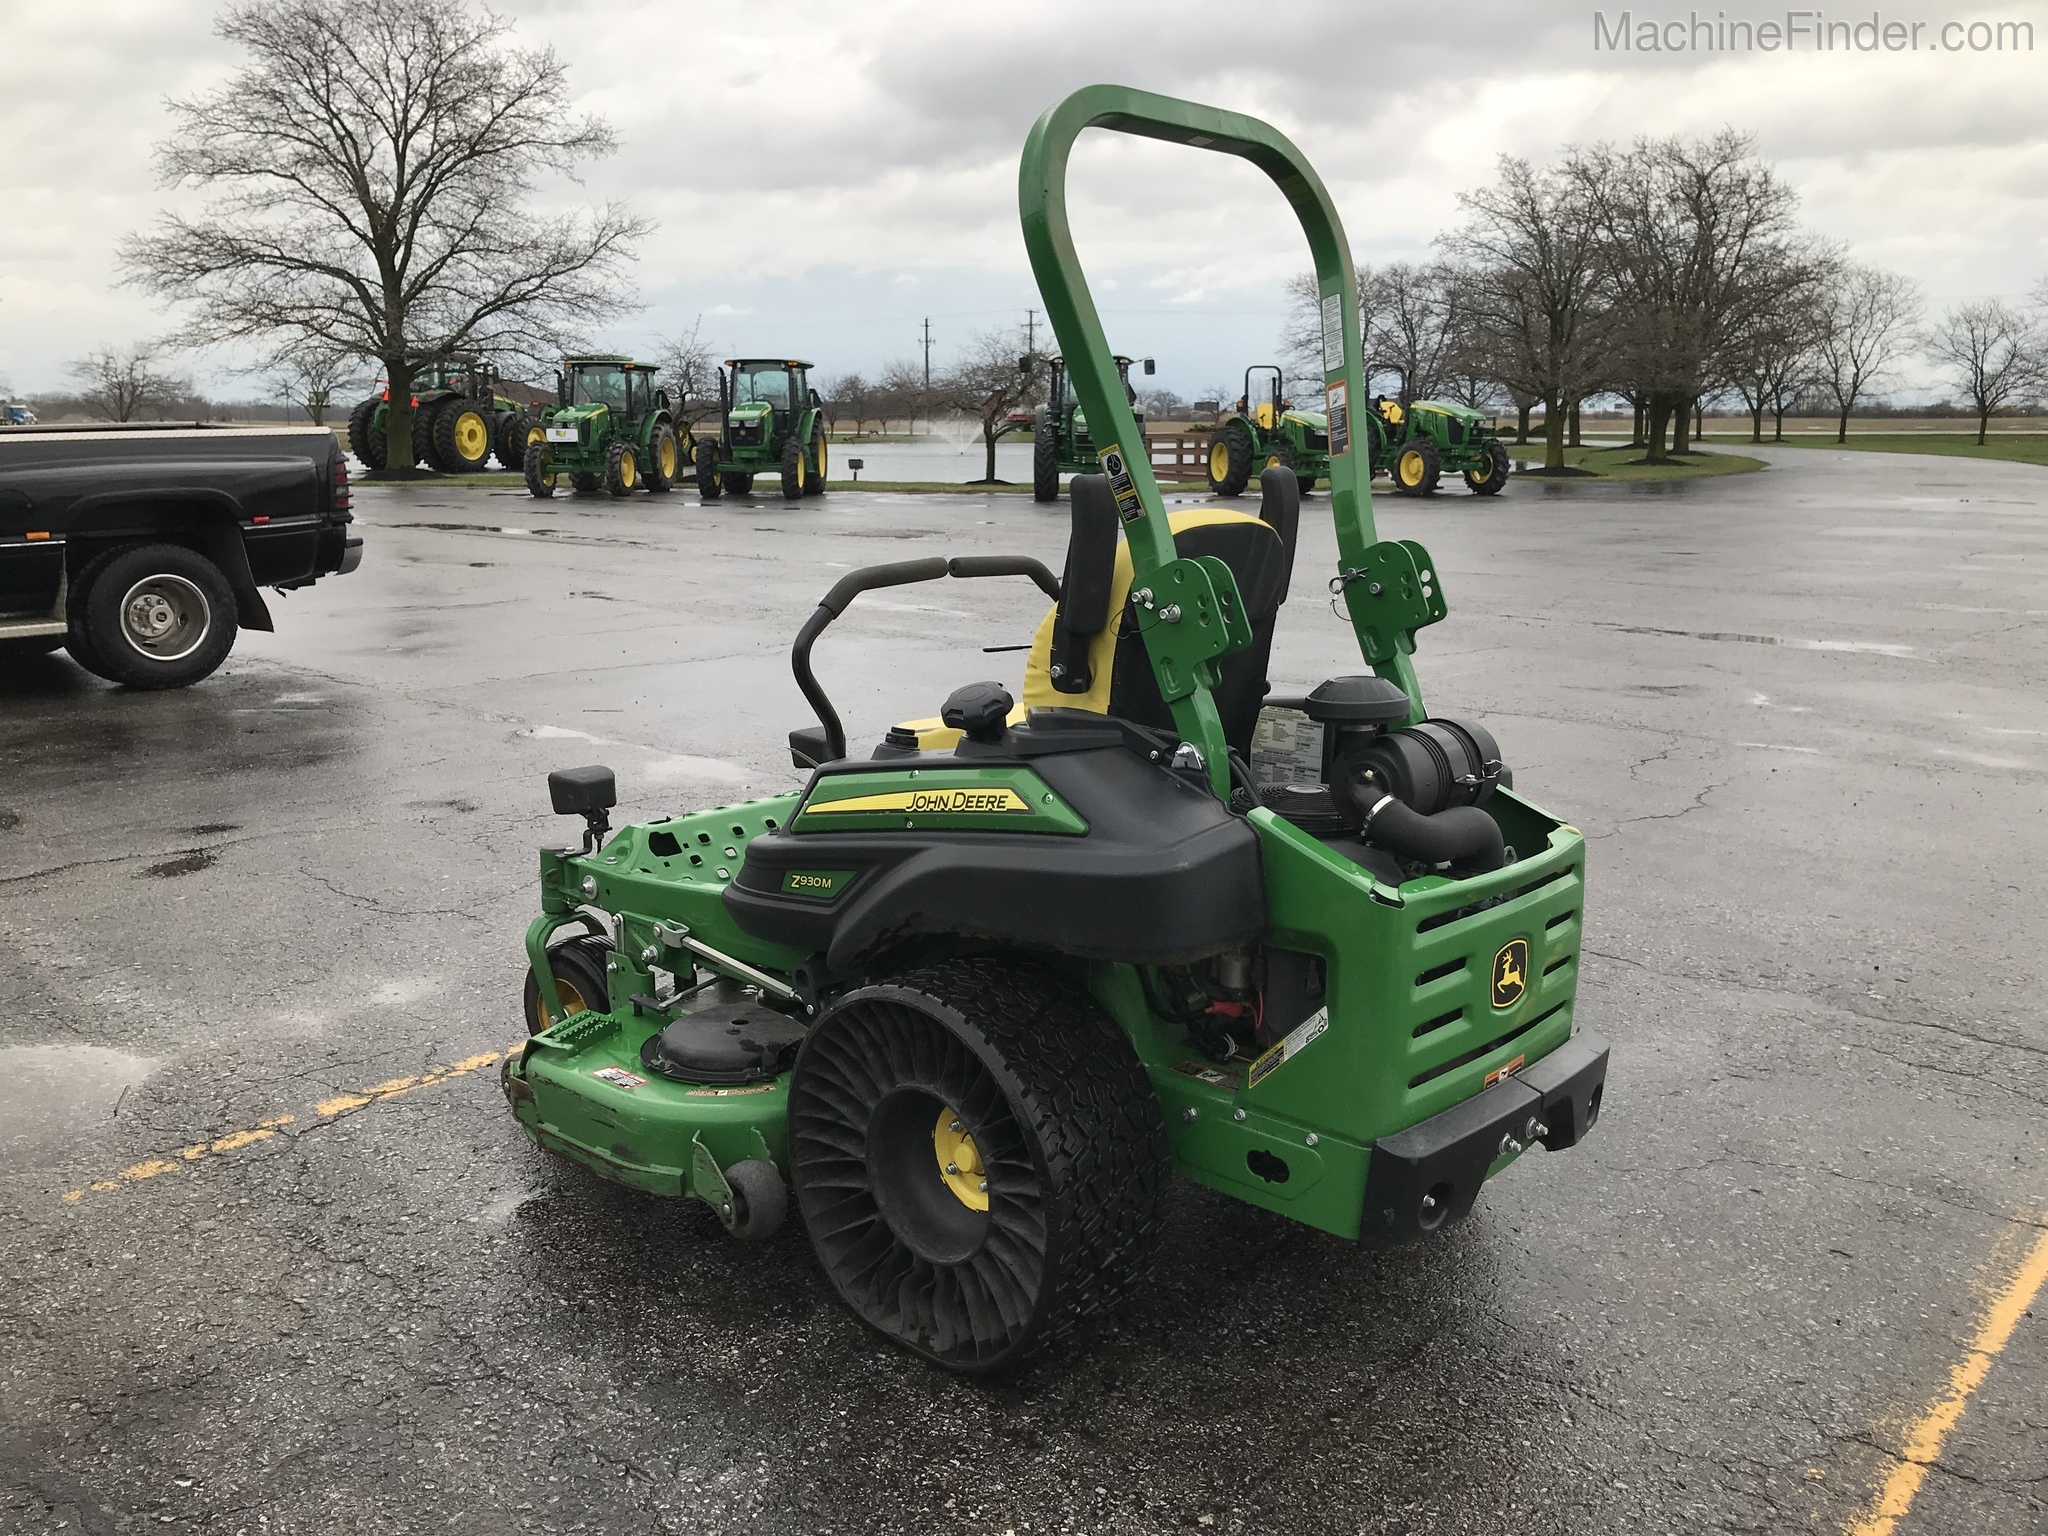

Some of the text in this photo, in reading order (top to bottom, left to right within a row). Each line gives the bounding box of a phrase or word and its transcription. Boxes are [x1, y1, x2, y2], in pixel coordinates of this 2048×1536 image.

[905, 792, 1009, 811] JOHN DEERE
[791, 874, 832, 889] Z930M
